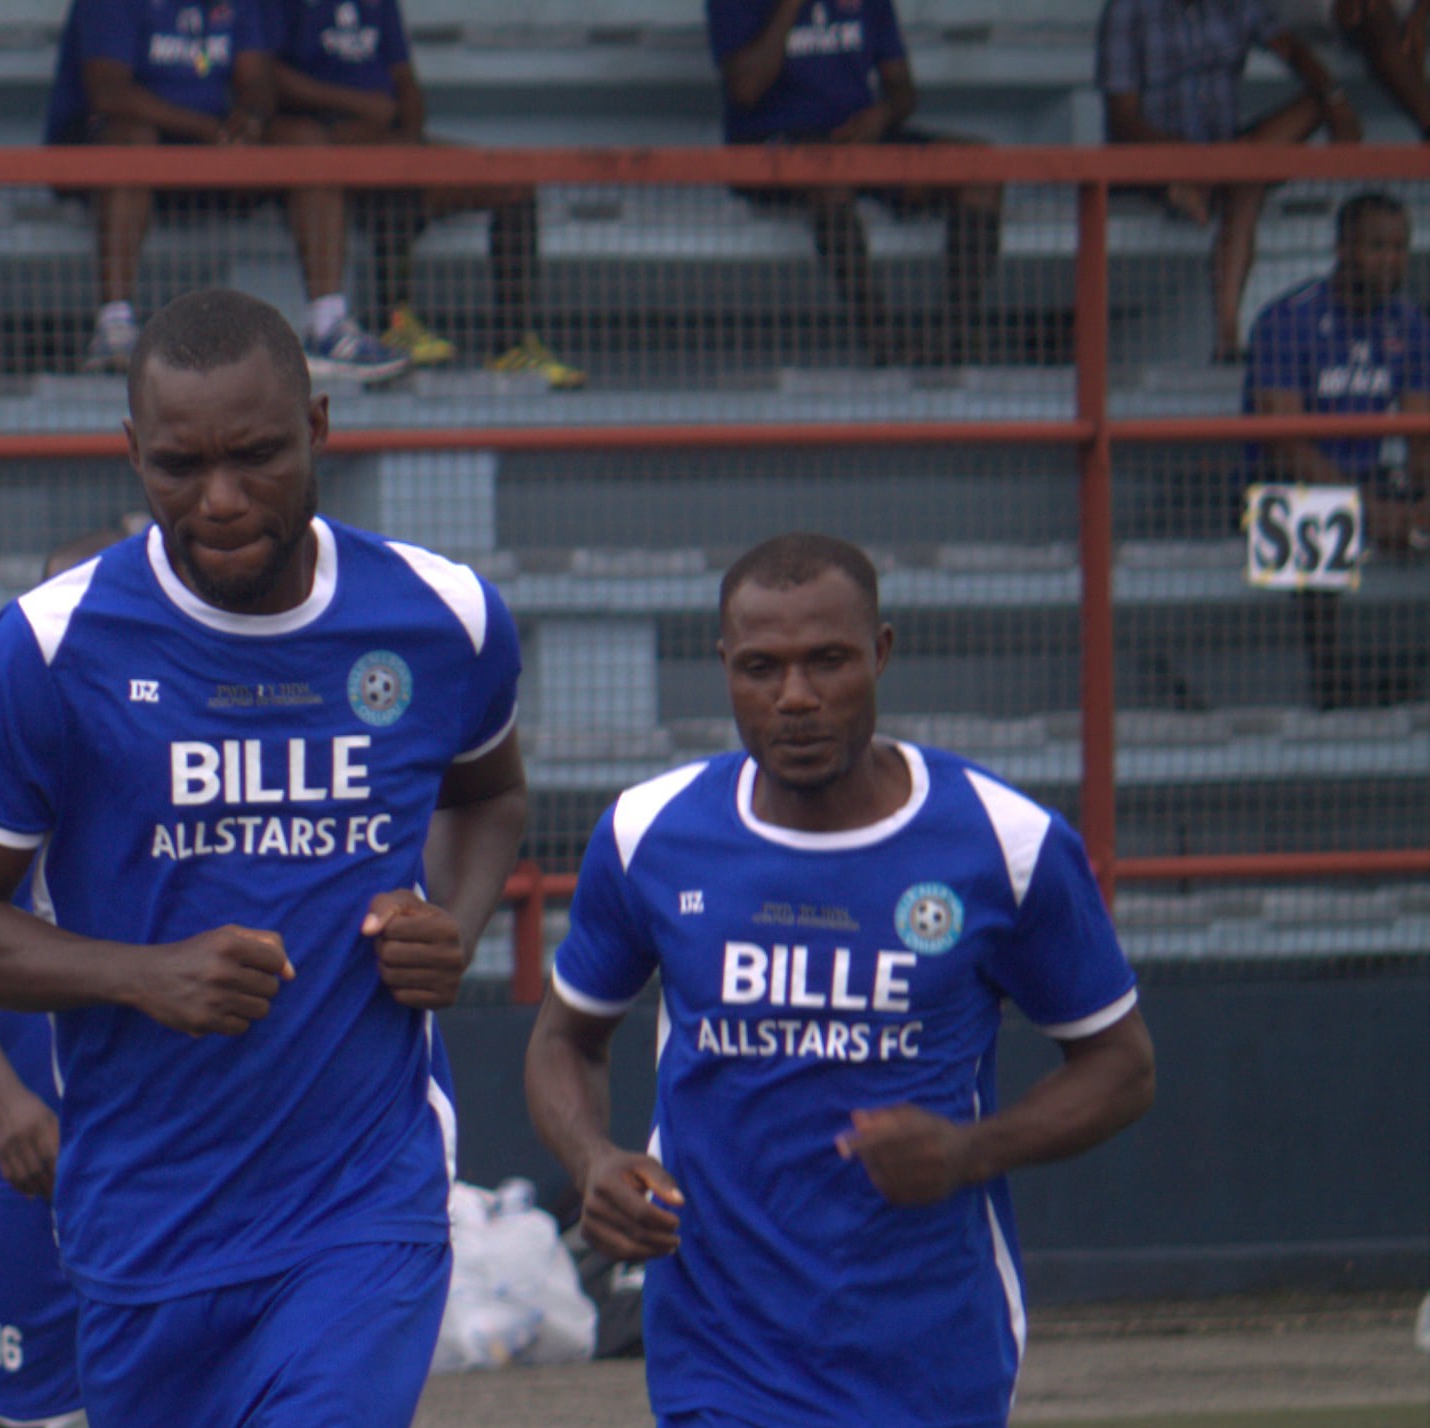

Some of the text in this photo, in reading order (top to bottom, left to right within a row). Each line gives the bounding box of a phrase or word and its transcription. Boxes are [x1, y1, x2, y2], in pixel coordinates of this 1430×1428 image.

[170, 735, 371, 806] BILLE
[151, 814, 391, 860] ALLSTARS FC
[721, 941, 917, 1013] BILLE
[697, 1016, 922, 1062] ALLSTARS FC
